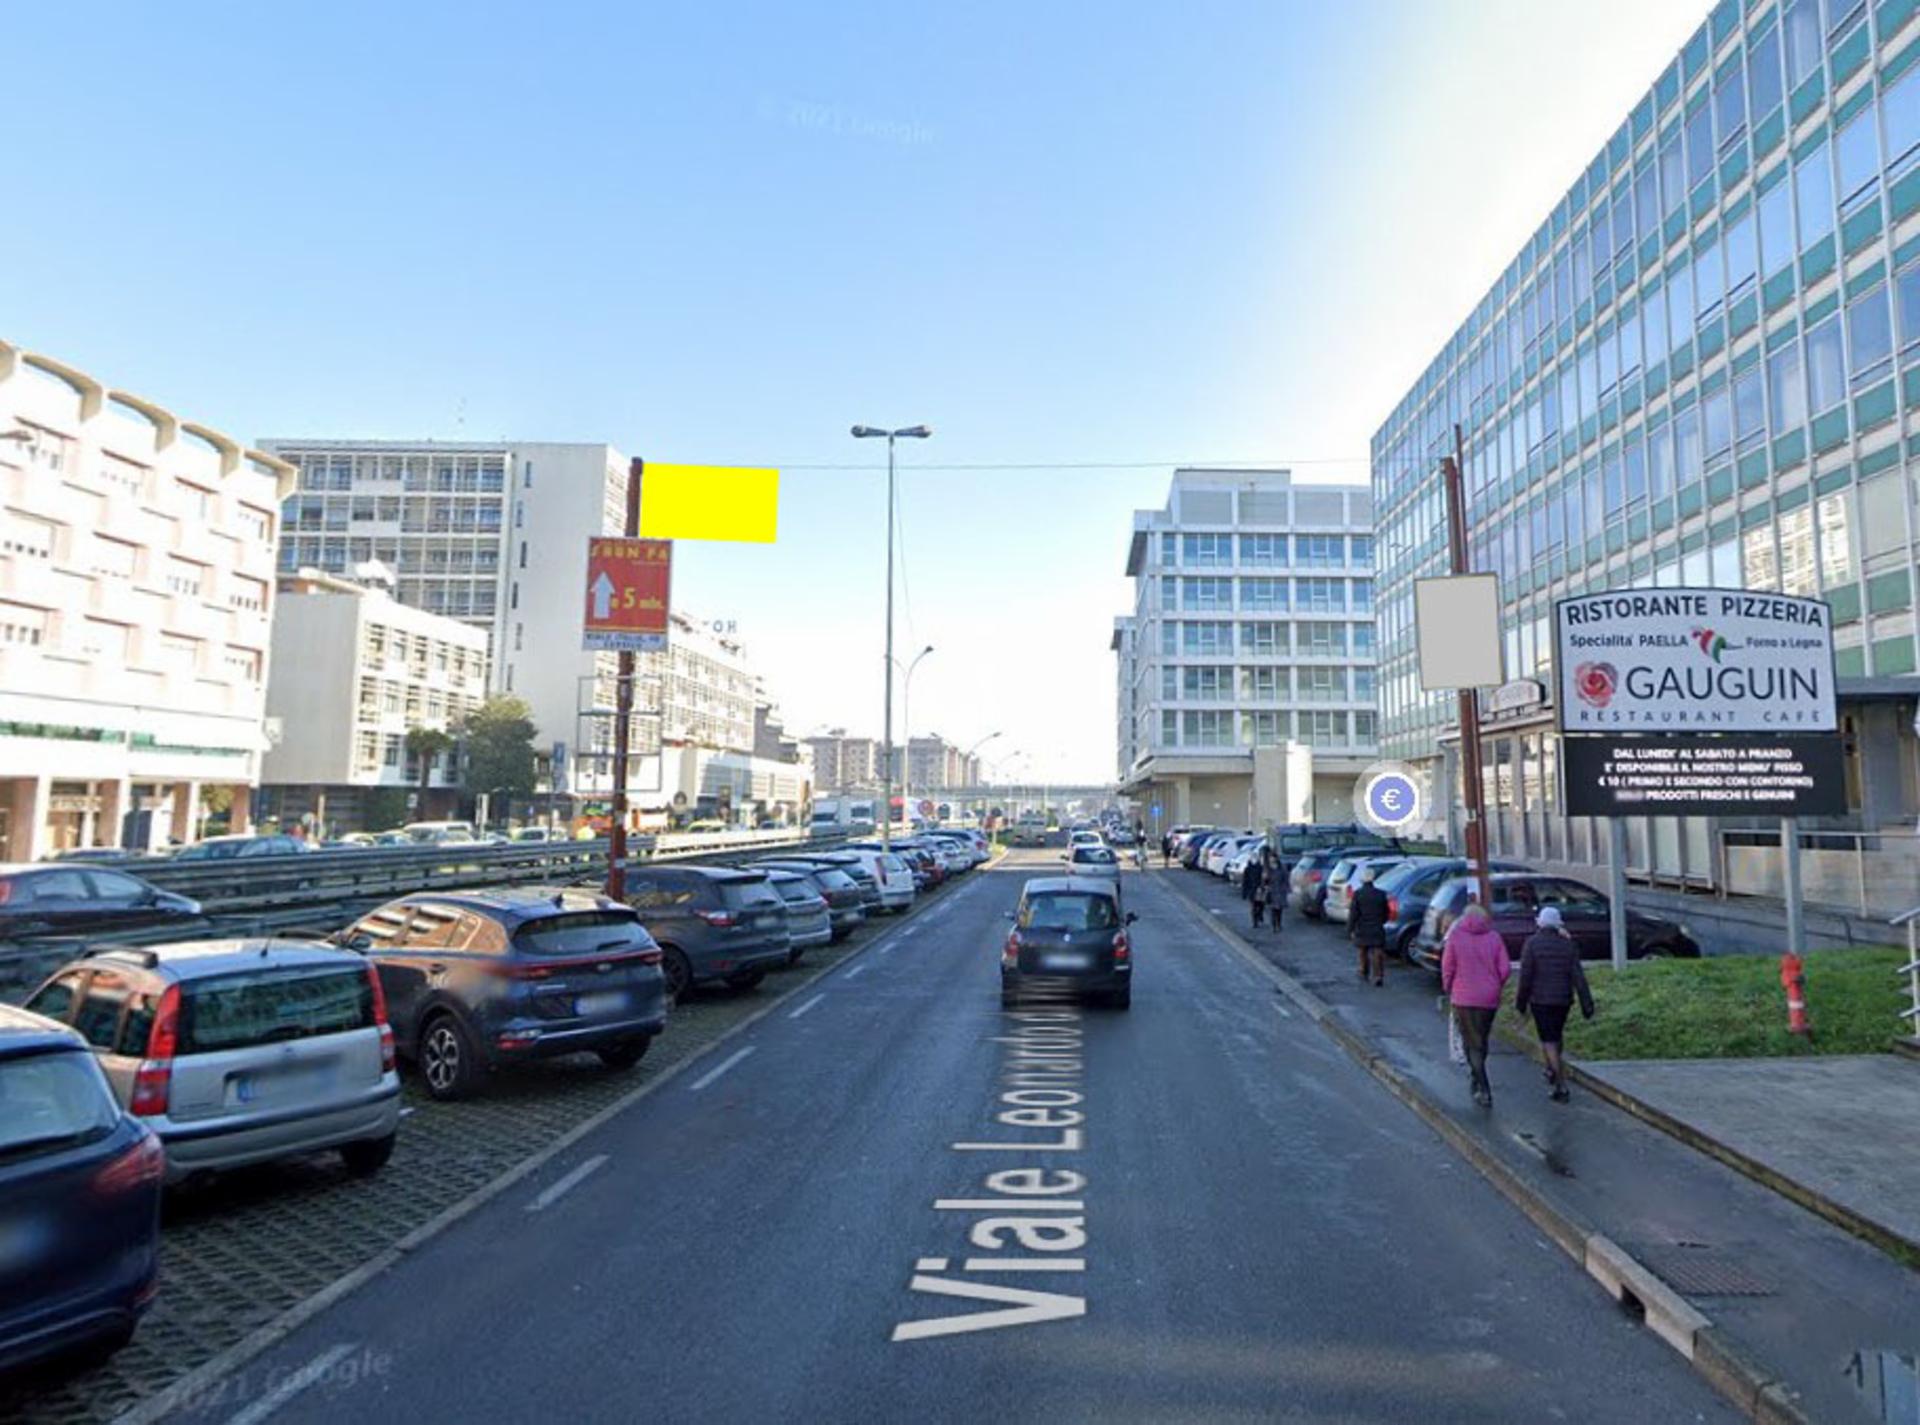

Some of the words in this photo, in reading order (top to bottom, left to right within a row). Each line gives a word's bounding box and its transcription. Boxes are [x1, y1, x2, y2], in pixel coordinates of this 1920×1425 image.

[623, 586, 636, 609] 5
[1566, 596, 1707, 626] RISTORANTE
[1721, 596, 1823, 628] PIZZERIA
[1639, 634, 1689, 647] PAELLA
[1780, 639, 1787, 648] a
[1789, 638, 1823, 650] Legna
[1626, 666, 1818, 700] GAUGUIN
[1580, 710, 1735, 722] RESTAURANT
[1679, 749, 1692, 759] AL
[1694, 749, 1736, 759] SABATO
[1738, 749, 1746, 759] A
[1673, 776, 1722, 787] SECONDO
[1725, 776, 1748, 787] CON
